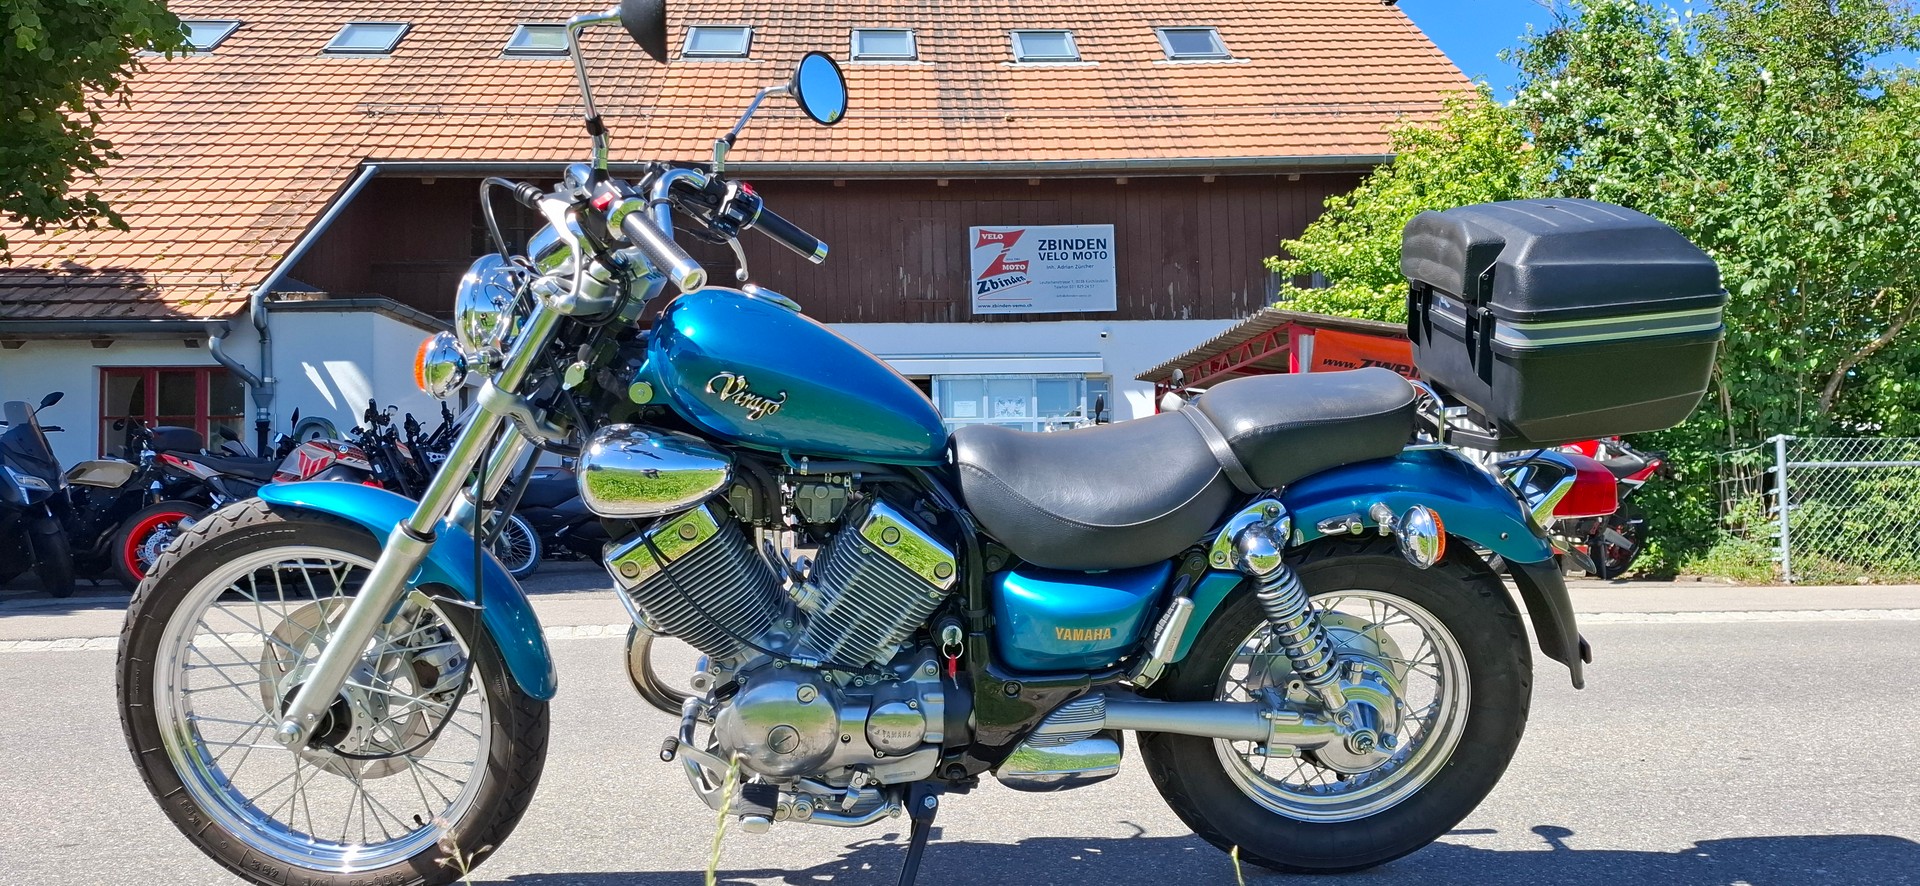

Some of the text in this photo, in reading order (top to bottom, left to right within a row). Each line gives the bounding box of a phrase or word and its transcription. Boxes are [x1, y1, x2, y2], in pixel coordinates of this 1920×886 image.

[1038, 238, 1107, 251] ZBINDEN
[1038, 250, 1108, 261] VELO MOTO
[976, 275, 1026, 295] Zbinden
[705, 371, 787, 420] Virago
[1055, 626, 1112, 641] YAMAHA
[882, 730, 912, 738] YAMAHA
